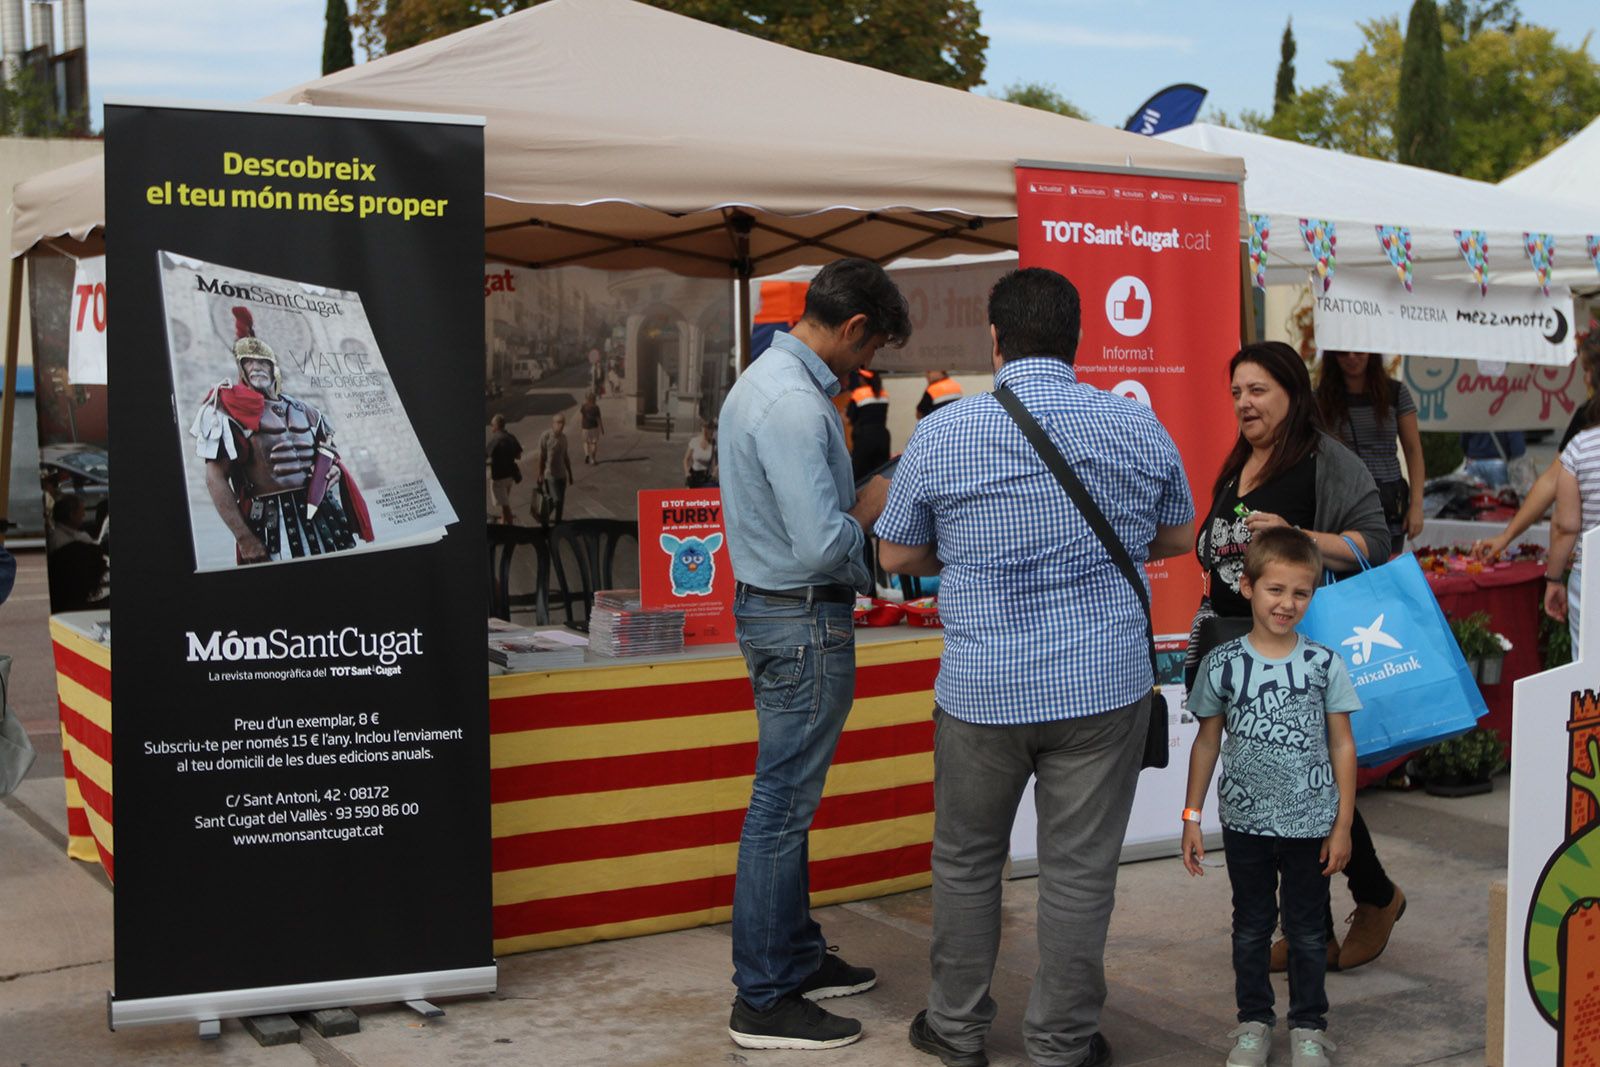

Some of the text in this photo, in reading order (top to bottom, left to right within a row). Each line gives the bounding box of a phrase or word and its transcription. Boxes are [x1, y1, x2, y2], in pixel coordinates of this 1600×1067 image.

[224, 152, 376, 181] Descobreix
[147, 182, 448, 220] el teu món més proper
[195, 274, 344, 318] MónSantCugat
[1316, 296, 1553, 329] TRATTORIA PIZZERIA mezzanotte
[1102, 346, 1154, 360] Informa't
[662, 508, 719, 524] FURBY
[670, 500, 684, 508] TOT
[186, 626, 423, 664] MónSantCugat
[208, 672, 220, 681] La
[222, 670, 253, 681] revista
[255, 668, 311, 682] monogràfica
[313, 668, 327, 678] del
[234, 712, 380, 731] Preu d'un exemplar, 8 €
[144, 728, 463, 754] Subscriu-te per només 15 € l'any. Inclou l'enviament
[177, 747, 434, 772] al teu domicili de les dues edicions anuals.
[226, 786, 390, 808] C/ Sant Antoni, 42 08172
[194, 802, 419, 829] Sant Cugat del Vallès 93 590 86 00
[233, 823, 384, 845] www.monsantcugat.cat
